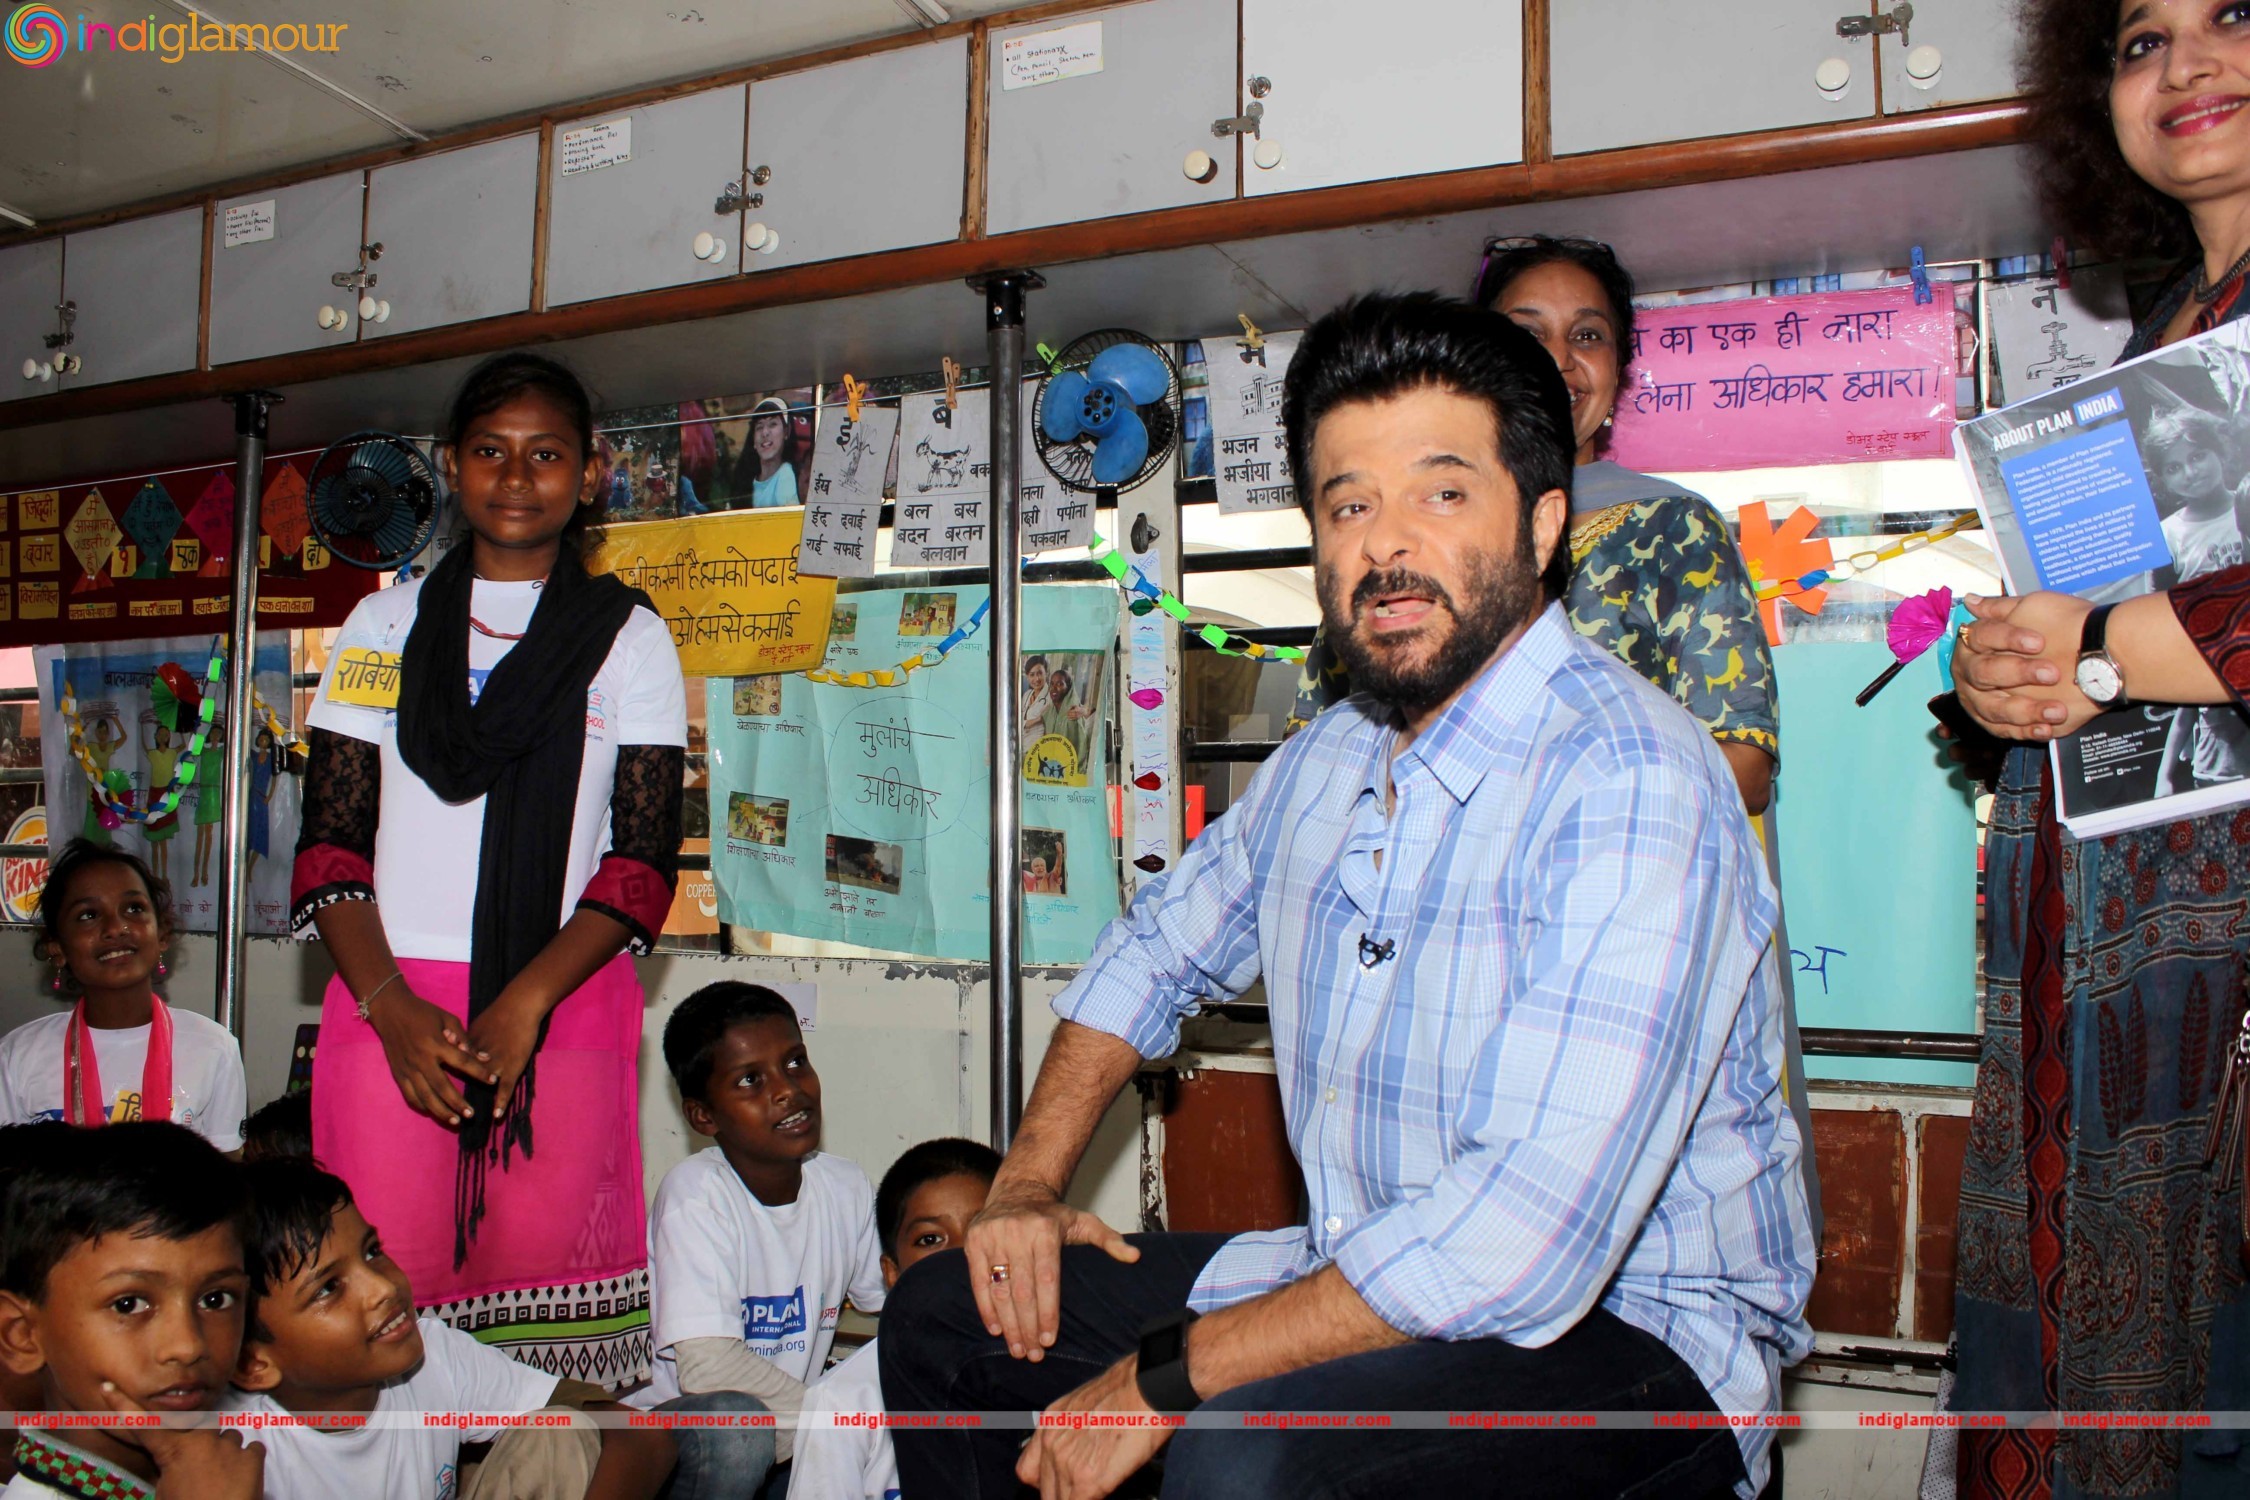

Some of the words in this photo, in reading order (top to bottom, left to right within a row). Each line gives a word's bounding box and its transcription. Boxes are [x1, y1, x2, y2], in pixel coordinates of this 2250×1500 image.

[1659, 325, 1698, 354] का
[1707, 322, 1757, 350] एक
[1774, 310, 1809, 349] ही
[1709, 364, 1834, 409] अधिकार
[1992, 423, 2035, 453] ABOUT
[2036, 409, 2074, 437] PLAN
[2077, 394, 2119, 422] INDIA
[1222, 437, 1260, 456] भजन
[969, 463, 991, 479] बक
[1224, 458, 1272, 484] भजीया
[1021, 485, 1045, 501] तला
[841, 508, 867, 530] दवाई
[904, 503, 933, 520] बल
[954, 502, 982, 520] बस
[1057, 502, 1089, 522] पपीता
[897, 527, 930, 544] बदन
[945, 524, 986, 543] बरतन
[1028, 529, 1071, 547] पकवान
[833, 535, 865, 561] सफाई
[920, 545, 969, 561] बलवान
[856, 767, 942, 820] अधिकार
[761, 848, 797, 868] अधिकार
[753, 1297, 800, 1323] PLAN
